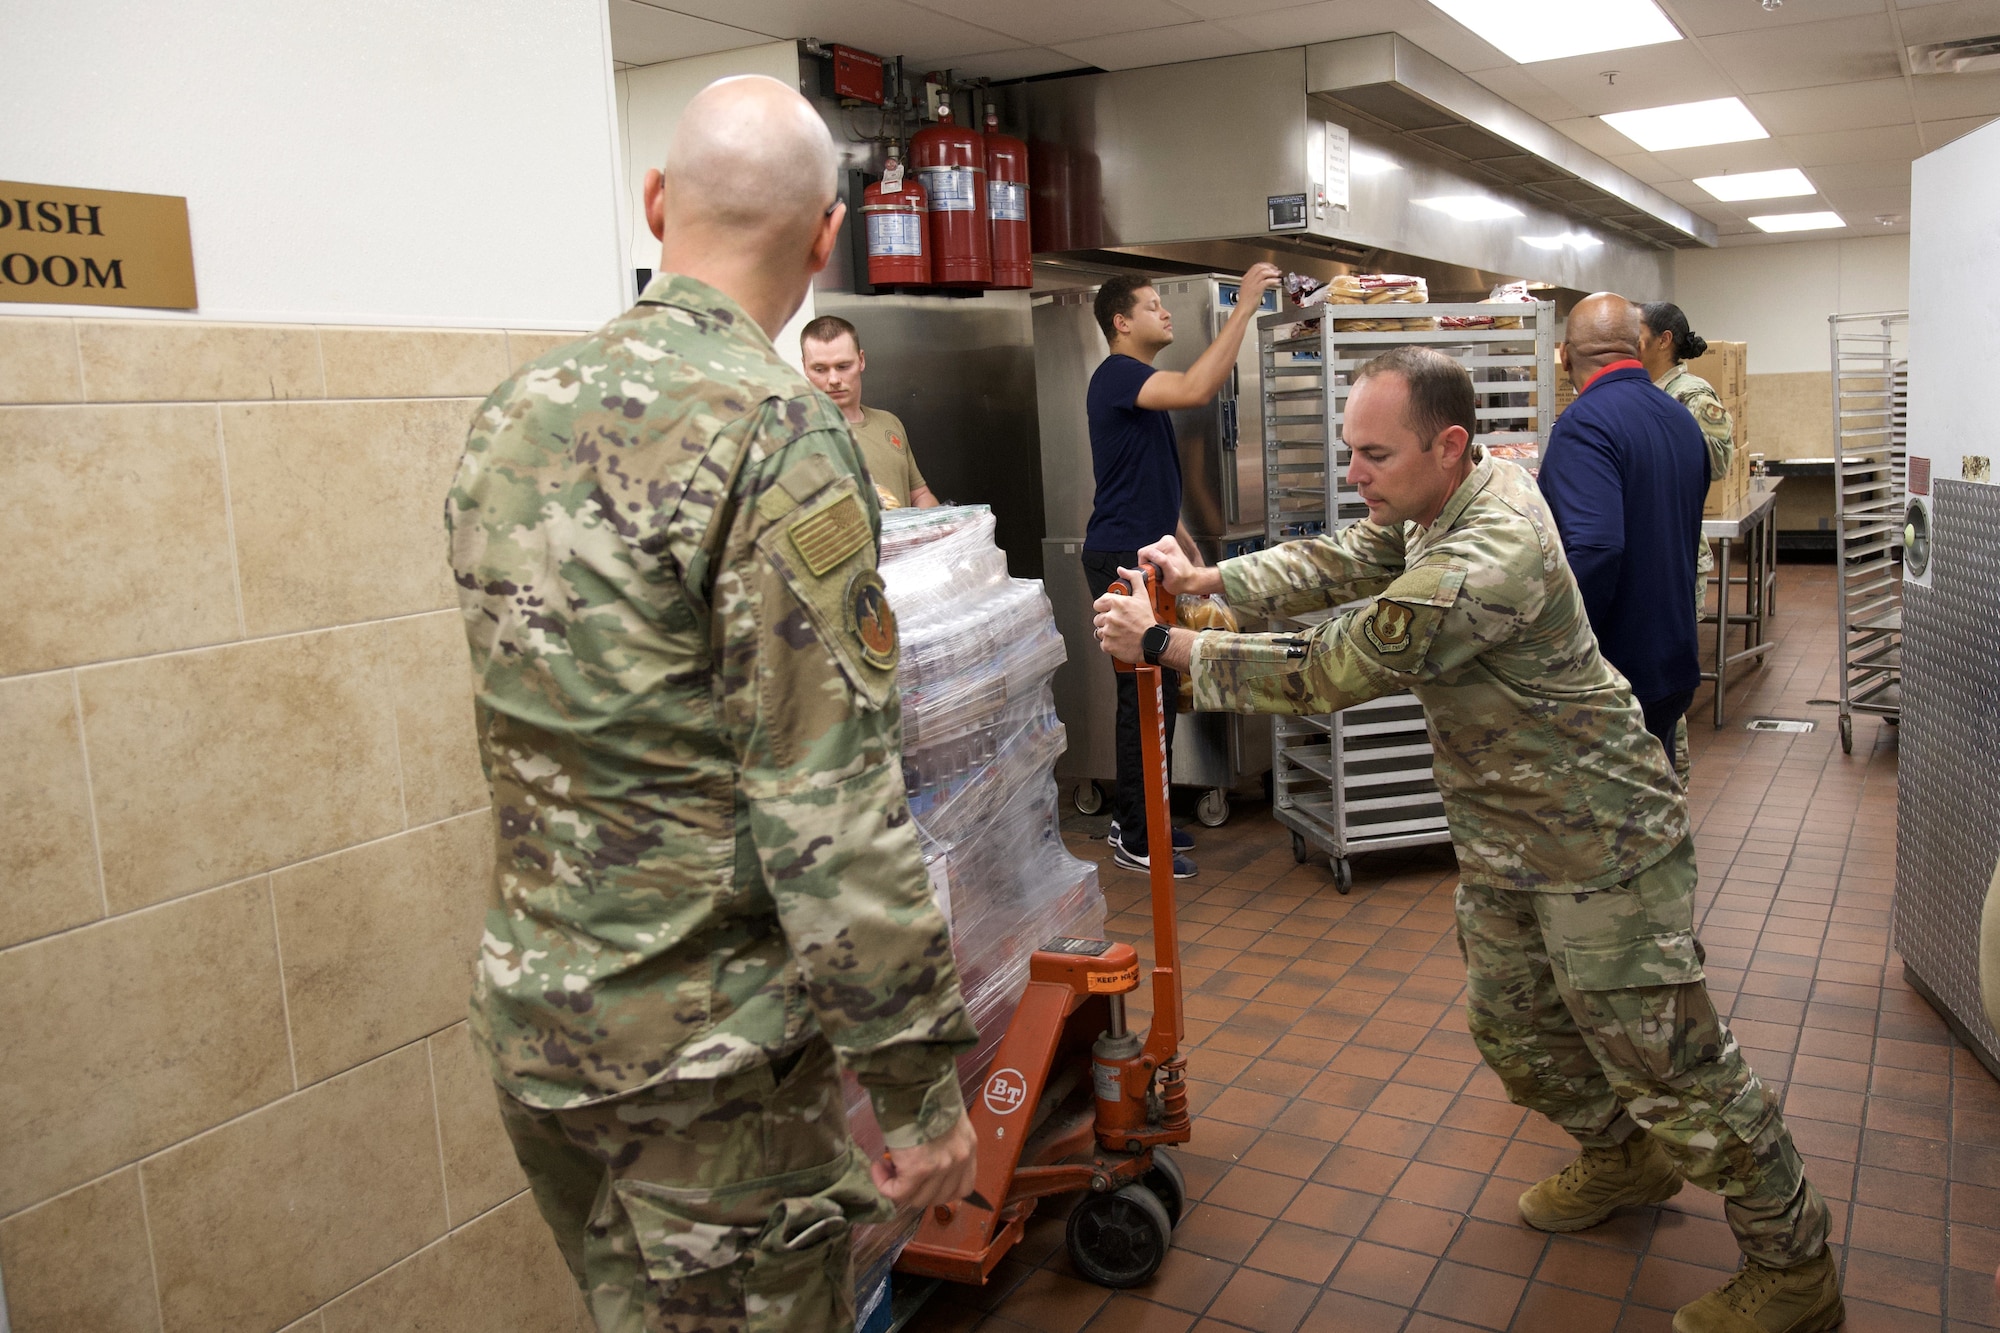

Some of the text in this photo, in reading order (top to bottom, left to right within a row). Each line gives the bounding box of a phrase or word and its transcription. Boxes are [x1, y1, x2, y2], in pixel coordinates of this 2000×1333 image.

[0, 253, 127, 289] OOM
[1156, 684, 1170, 805] BT LIFTER
[992, 1078, 1021, 1104] BT
